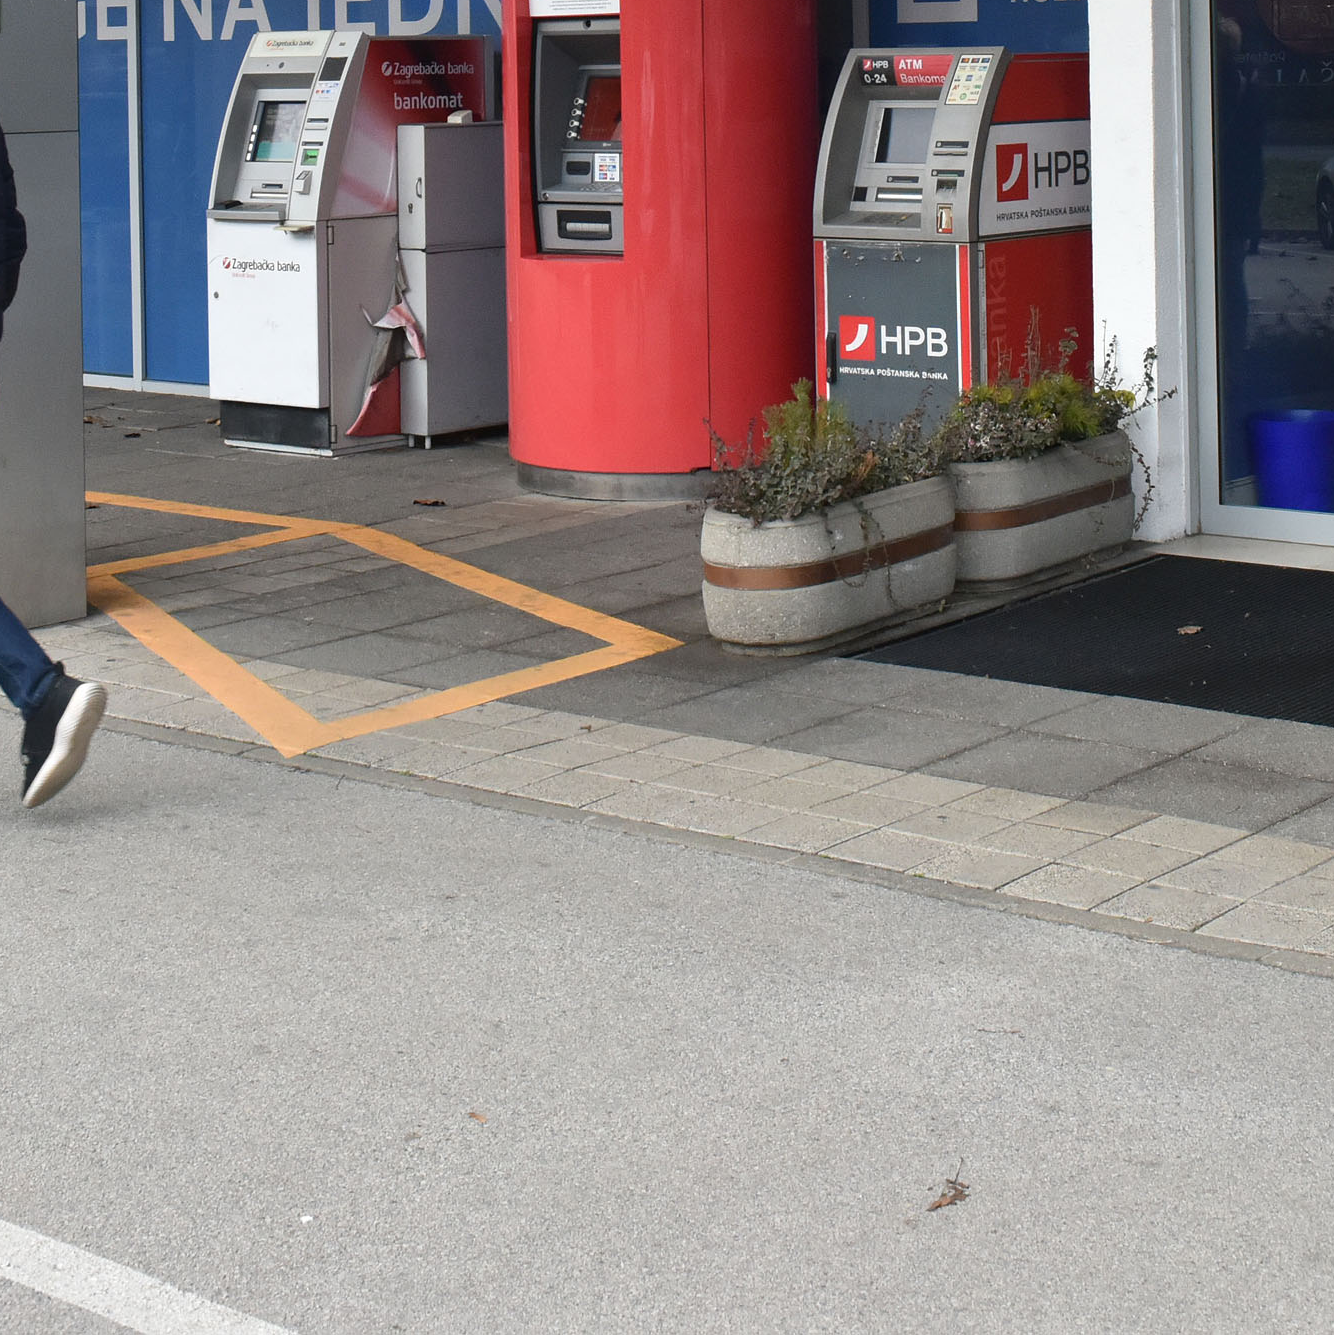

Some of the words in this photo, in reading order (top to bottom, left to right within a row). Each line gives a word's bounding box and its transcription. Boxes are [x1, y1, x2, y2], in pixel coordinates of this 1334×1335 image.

[394, 62, 445, 78] Zagrebačka
[448, 62, 474, 74] banka
[873, 61, 889, 69] HPB
[899, 59, 923, 69] ATM
[863, 74, 887, 84] 0-24
[900, 74, 946, 83] Bankoma
[394, 91, 463, 110] bankomat
[1034, 149, 1090, 189] HPB
[996, 211, 1029, 222] HRVATSKA
[1030, 206, 1067, 220] POŠTANSKA
[1068, 205, 1090, 215] BANKA
[232, 258, 274, 272] Zagrebačka
[277, 261, 300, 272] banka
[880, 324, 949, 358] HPB
[839, 366, 875, 377] HRVATSKA
[877, 367, 920, 379] POŠTANSKA
